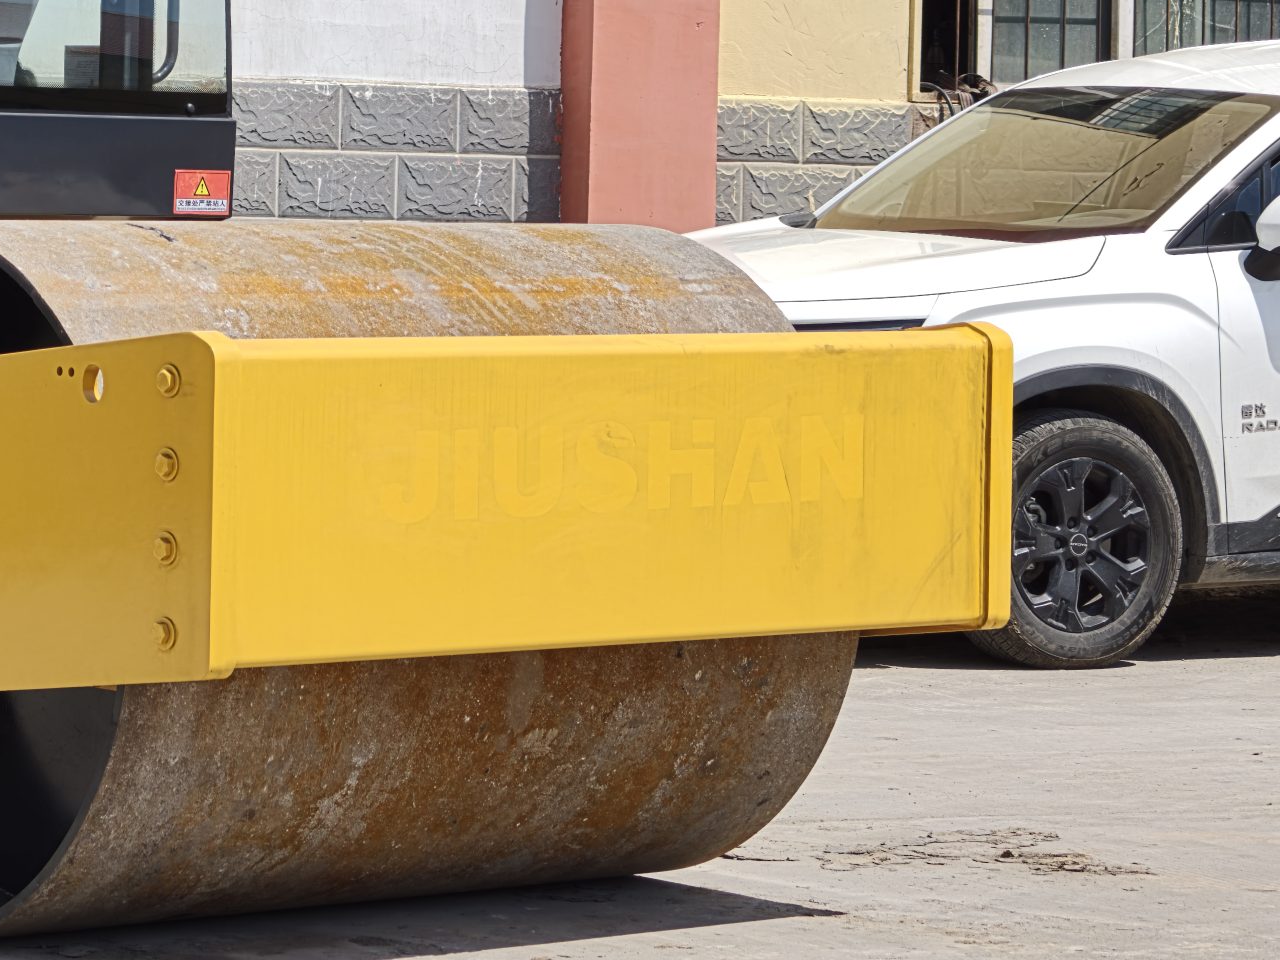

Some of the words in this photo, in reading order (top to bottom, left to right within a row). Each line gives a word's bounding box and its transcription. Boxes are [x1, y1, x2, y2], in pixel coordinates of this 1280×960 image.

[177, 199, 226, 208] 交接处严禁站人
[1241, 420, 1280, 434] RAD
[380, 414, 865, 524] JIUSHAN
